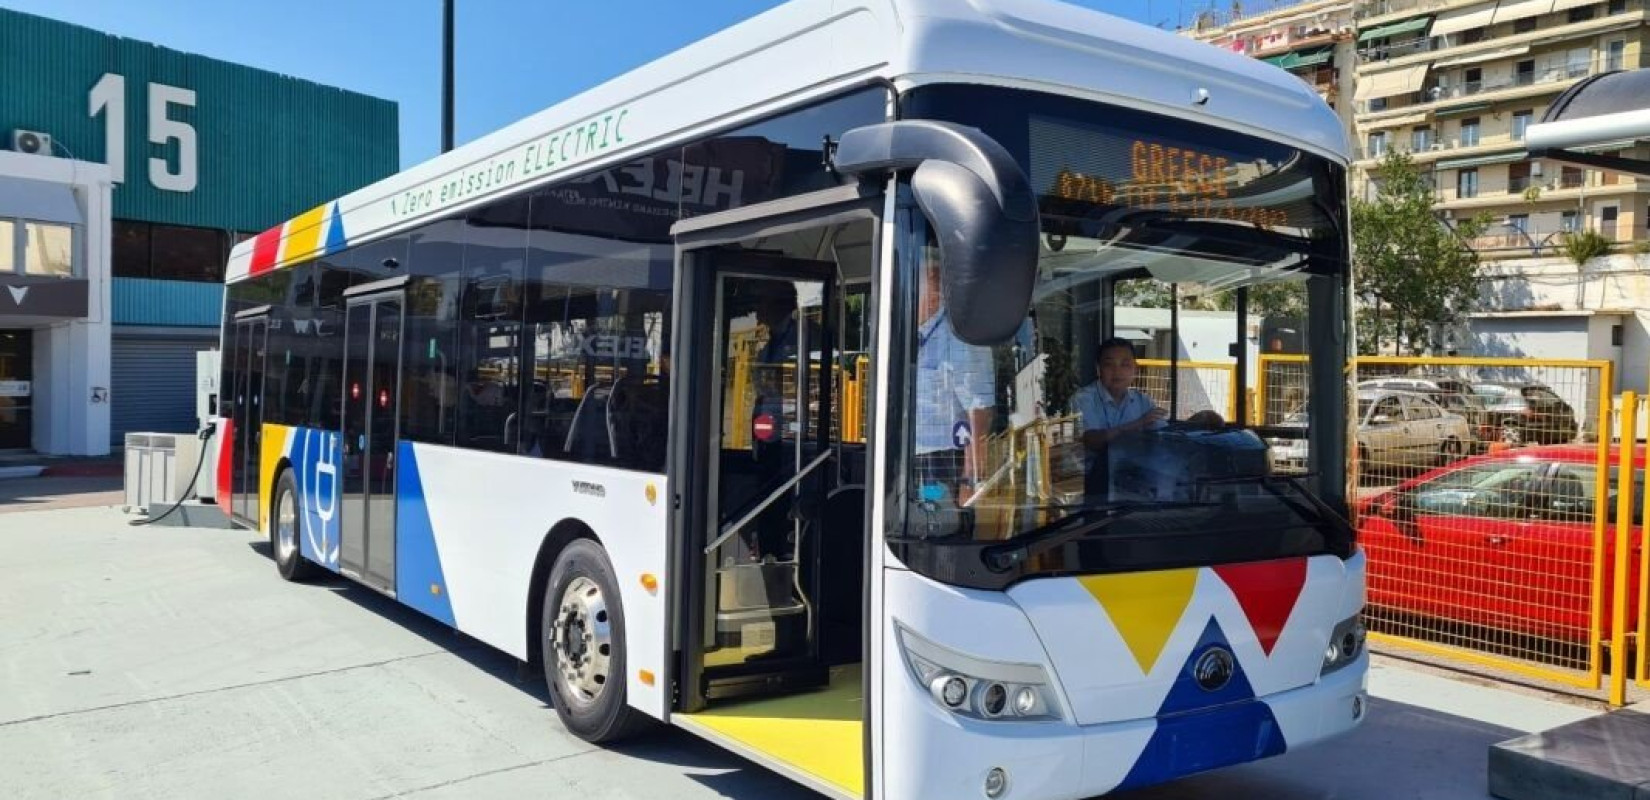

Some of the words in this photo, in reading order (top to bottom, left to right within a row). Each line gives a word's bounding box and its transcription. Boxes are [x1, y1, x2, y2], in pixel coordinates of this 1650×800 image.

[88, 73, 198, 193] 15
[401, 186, 433, 216] Zero
[440, 160, 515, 202] emission
[522, 109, 628, 175] ELECTRIC
[1131, 140, 1229, 197] GREECE
